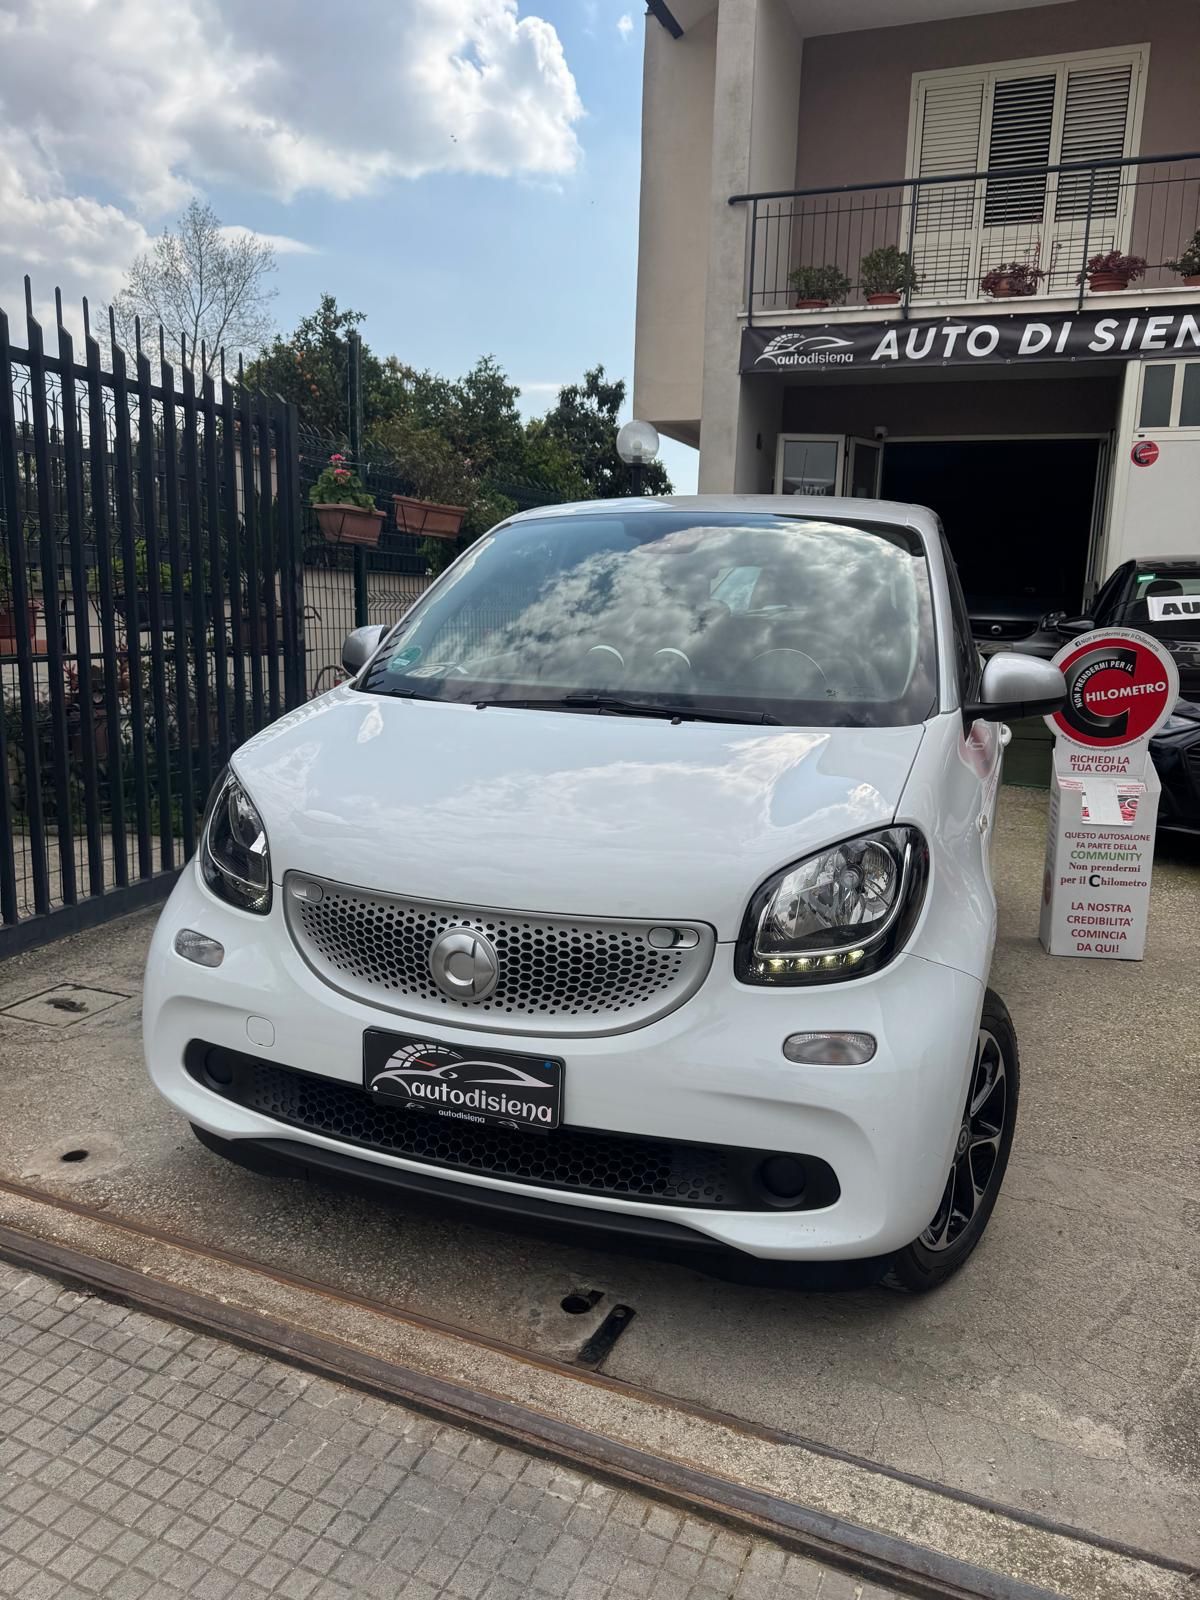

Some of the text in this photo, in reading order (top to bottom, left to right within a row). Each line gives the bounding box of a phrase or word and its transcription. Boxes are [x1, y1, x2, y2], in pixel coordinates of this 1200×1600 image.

[870, 324, 1000, 361] AUTO
[1017, 321, 1072, 354] DI
[777, 352, 854, 365] autodisiena
[1162, 601, 1200, 615] AU
[1074, 660, 1134, 709] NON PRENDERMI PER IL
[1070, 754, 1130, 765] RICHIEDI LA
[1072, 764, 1127, 773] TUA COPIA
[1064, 831, 1151, 842] QUESTO AUTOSALONE
[1087, 842, 1112, 850] PARTE
[1114, 843, 1137, 851] DELLA
[1070, 850, 1143, 861] COMMUNITY
[1069, 862, 1141, 873] Non prendermi
[1060, 874, 1148, 888] per il Chilometro
[1071, 902, 1132, 913] LA NOSTRA
[1071, 928, 1127, 940] COMINCIA
[1076, 942, 1120, 954] DA QUI!
[411, 1081, 552, 1123] autodisiena
[438, 1109, 485, 1124] autodisiena
